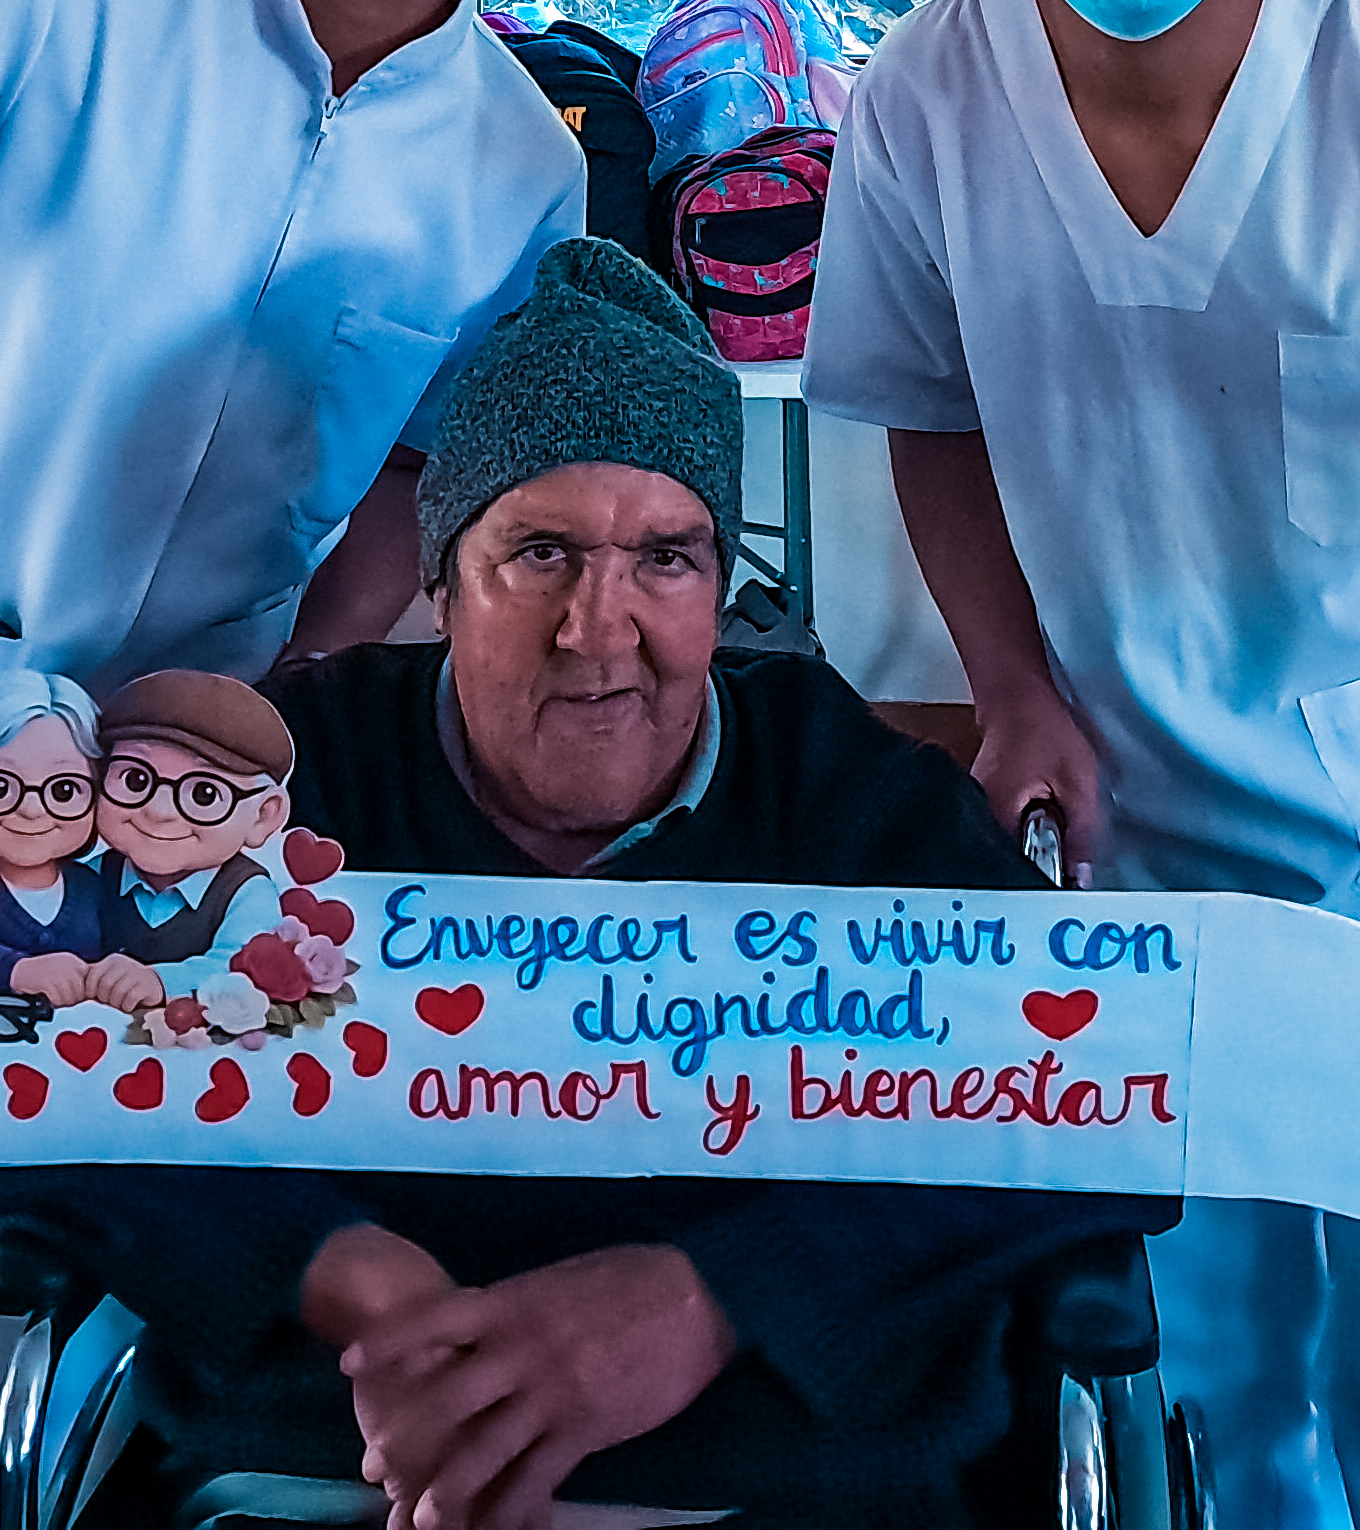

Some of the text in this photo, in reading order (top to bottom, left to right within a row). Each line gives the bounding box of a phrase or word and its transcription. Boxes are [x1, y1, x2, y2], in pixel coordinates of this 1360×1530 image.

[380, 883, 1182, 990] Envejecer es vivir con
[572, 966, 949, 1077] dignidad,
[408, 1045, 1176, 1156] amor y bienestar
